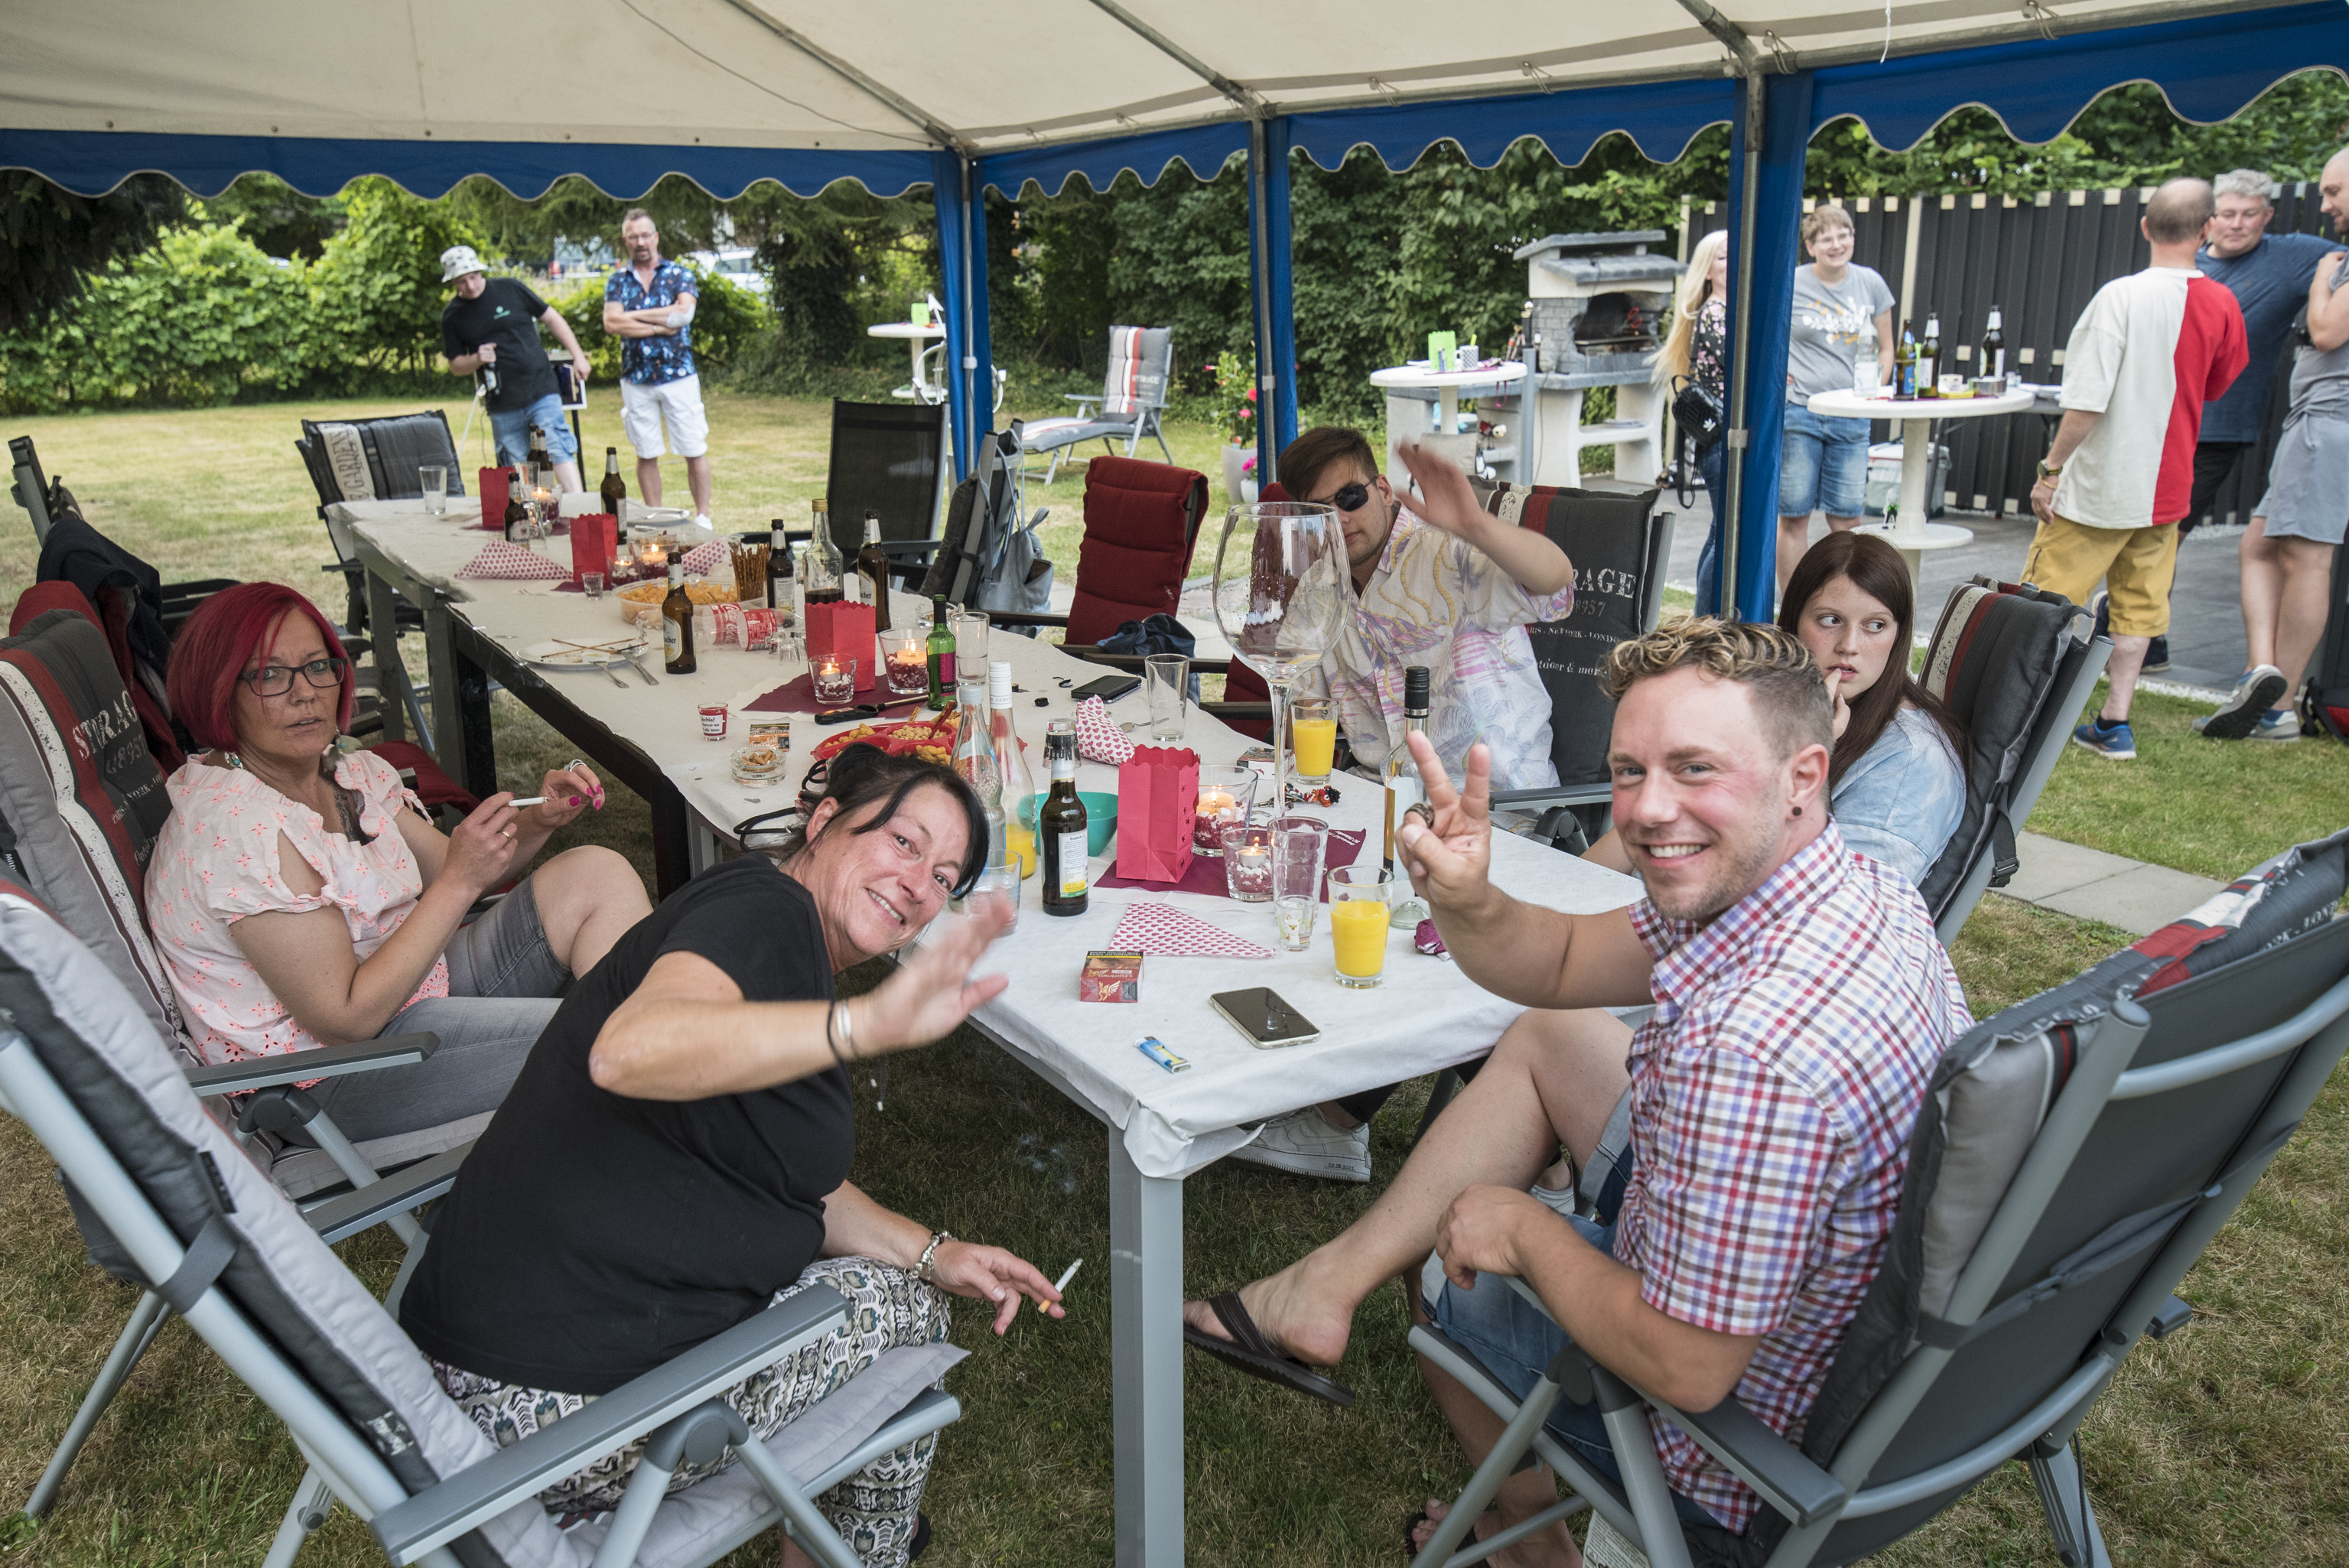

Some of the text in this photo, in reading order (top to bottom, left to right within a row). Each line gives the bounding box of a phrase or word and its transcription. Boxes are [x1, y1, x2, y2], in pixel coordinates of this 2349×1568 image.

[1572, 568, 1636, 599] RAGE
[1574, 599, 1606, 616] 8957
[1526, 626, 1541, 635] ARIS
[1589, 632, 1616, 643] LOND
[1537, 659, 1564, 672] tdoor
[5, 854, 17, 871] MAD
